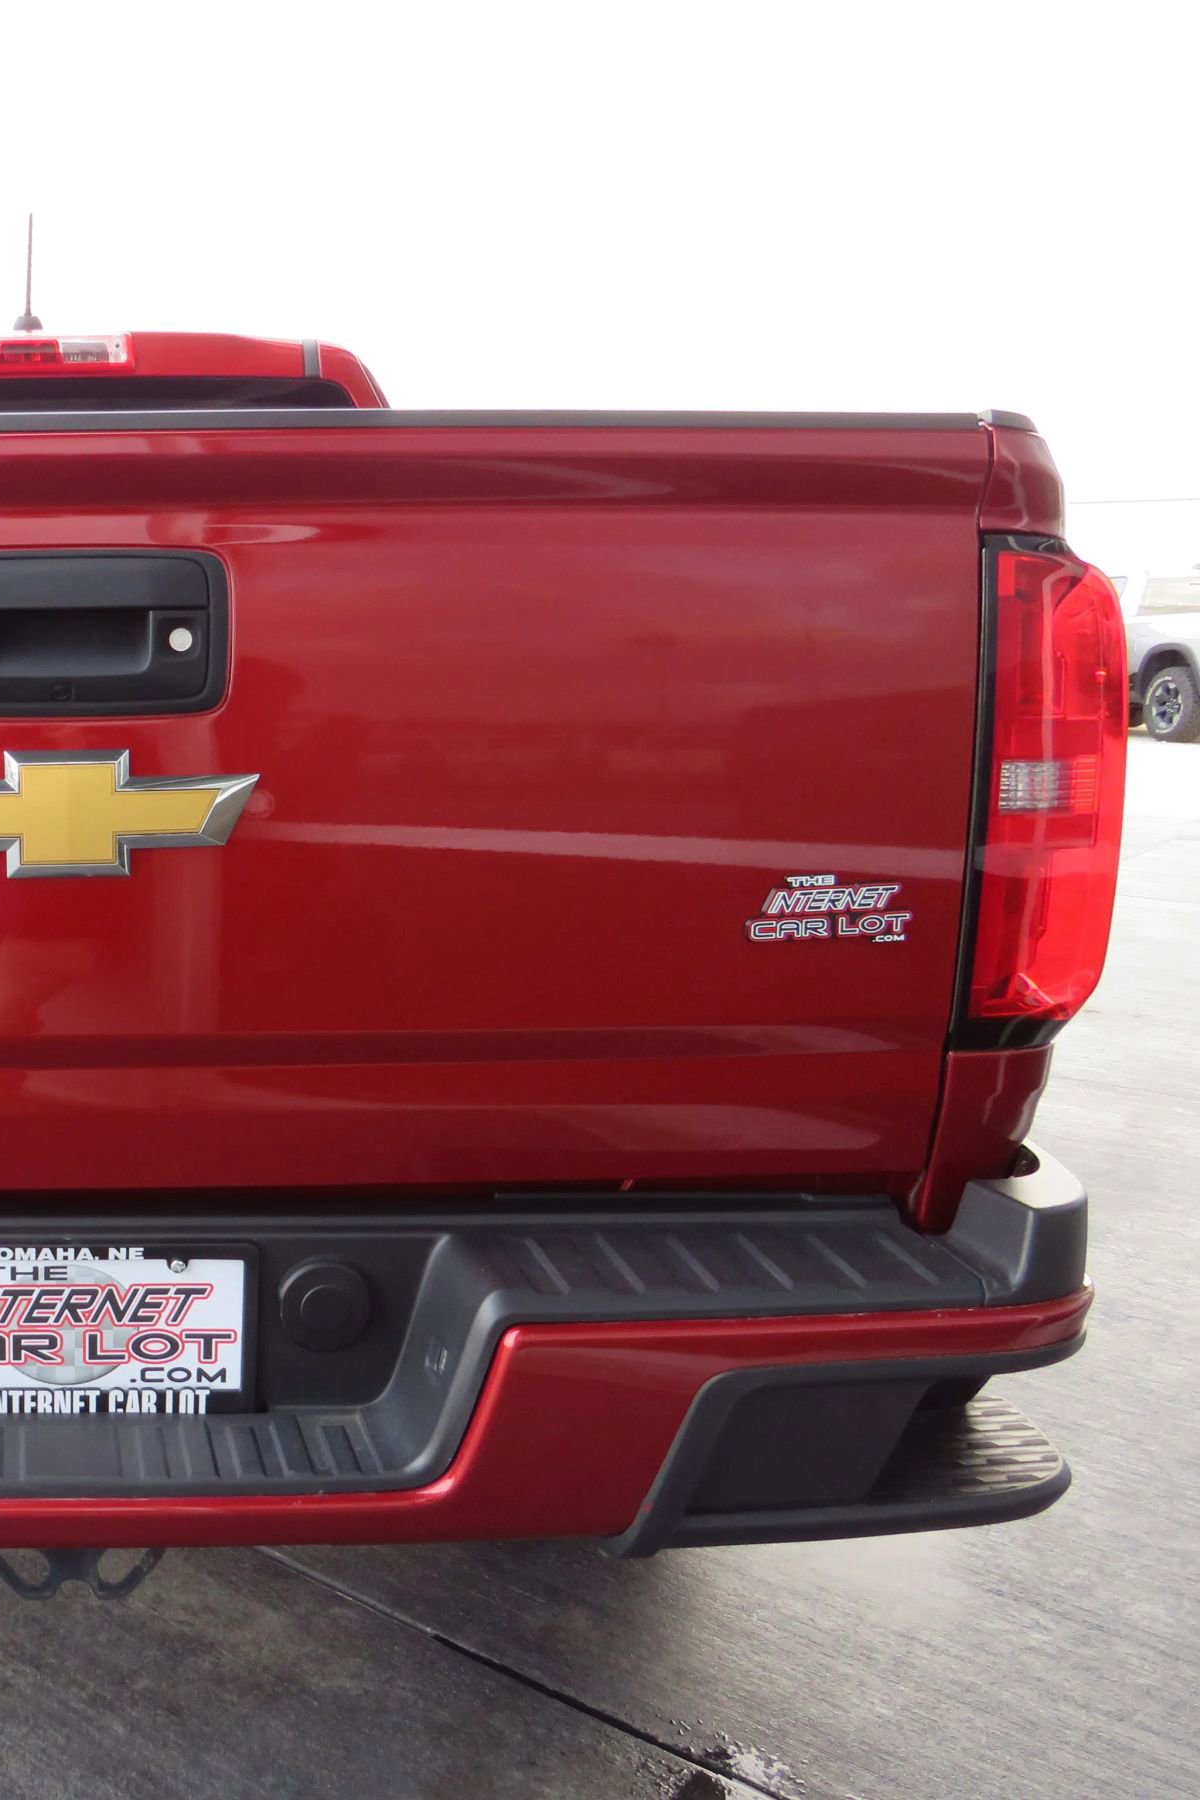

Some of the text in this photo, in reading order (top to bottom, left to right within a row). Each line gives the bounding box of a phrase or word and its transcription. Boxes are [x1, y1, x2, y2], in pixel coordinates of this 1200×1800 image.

[786, 875, 835, 887] THE
[765, 884, 900, 915] INTERNET
[749, 912, 911, 941] CAR LOT
[108, 1247, 144, 1261] NE
[84, 1330, 236, 1364] LOT
[129, 1367, 227, 1383] .COM
[108, 1388, 157, 1413] CAR
